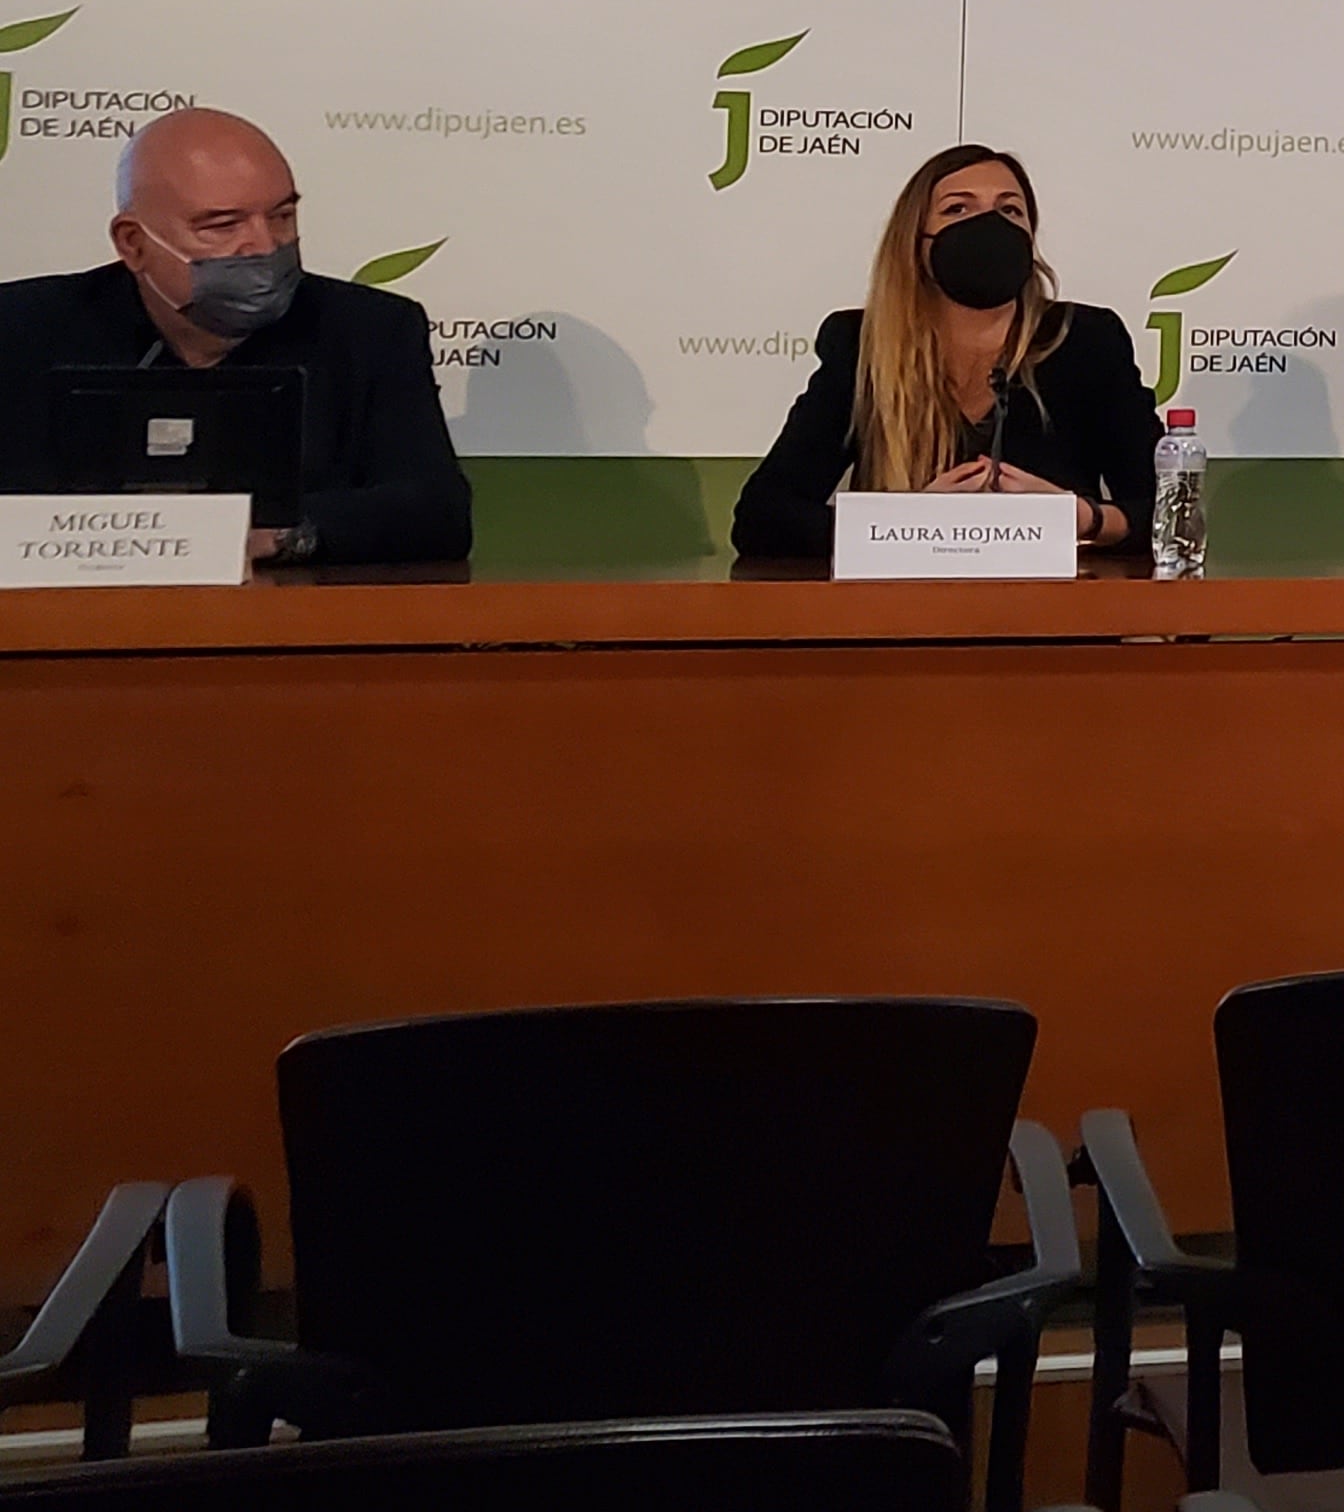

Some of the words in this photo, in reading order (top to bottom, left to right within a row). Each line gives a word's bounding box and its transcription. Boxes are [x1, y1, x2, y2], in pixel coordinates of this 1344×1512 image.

[21, 89, 197, 112] DIPUTACIÓN
[20, 117, 59, 137] DE
[64, 116, 135, 138] JAÉN
[324, 107, 587, 139] www.dipujaen.es
[760, 109, 913, 130] DIPUTACIÓN
[759, 135, 793, 153] DE
[797, 134, 860, 155] JAÉN
[1190, 326, 1337, 348] DIPUTACIÓN
[432, 345, 500, 366] JAÉN
[1190, 354, 1223, 372] DE
[1226, 352, 1287, 373] JAÉN
[49, 511, 167, 532] MIGUEL
[869, 524, 945, 542] LAURA
[952, 526, 1043, 544] HOJMAN
[17, 537, 192, 560] TORRENTE
